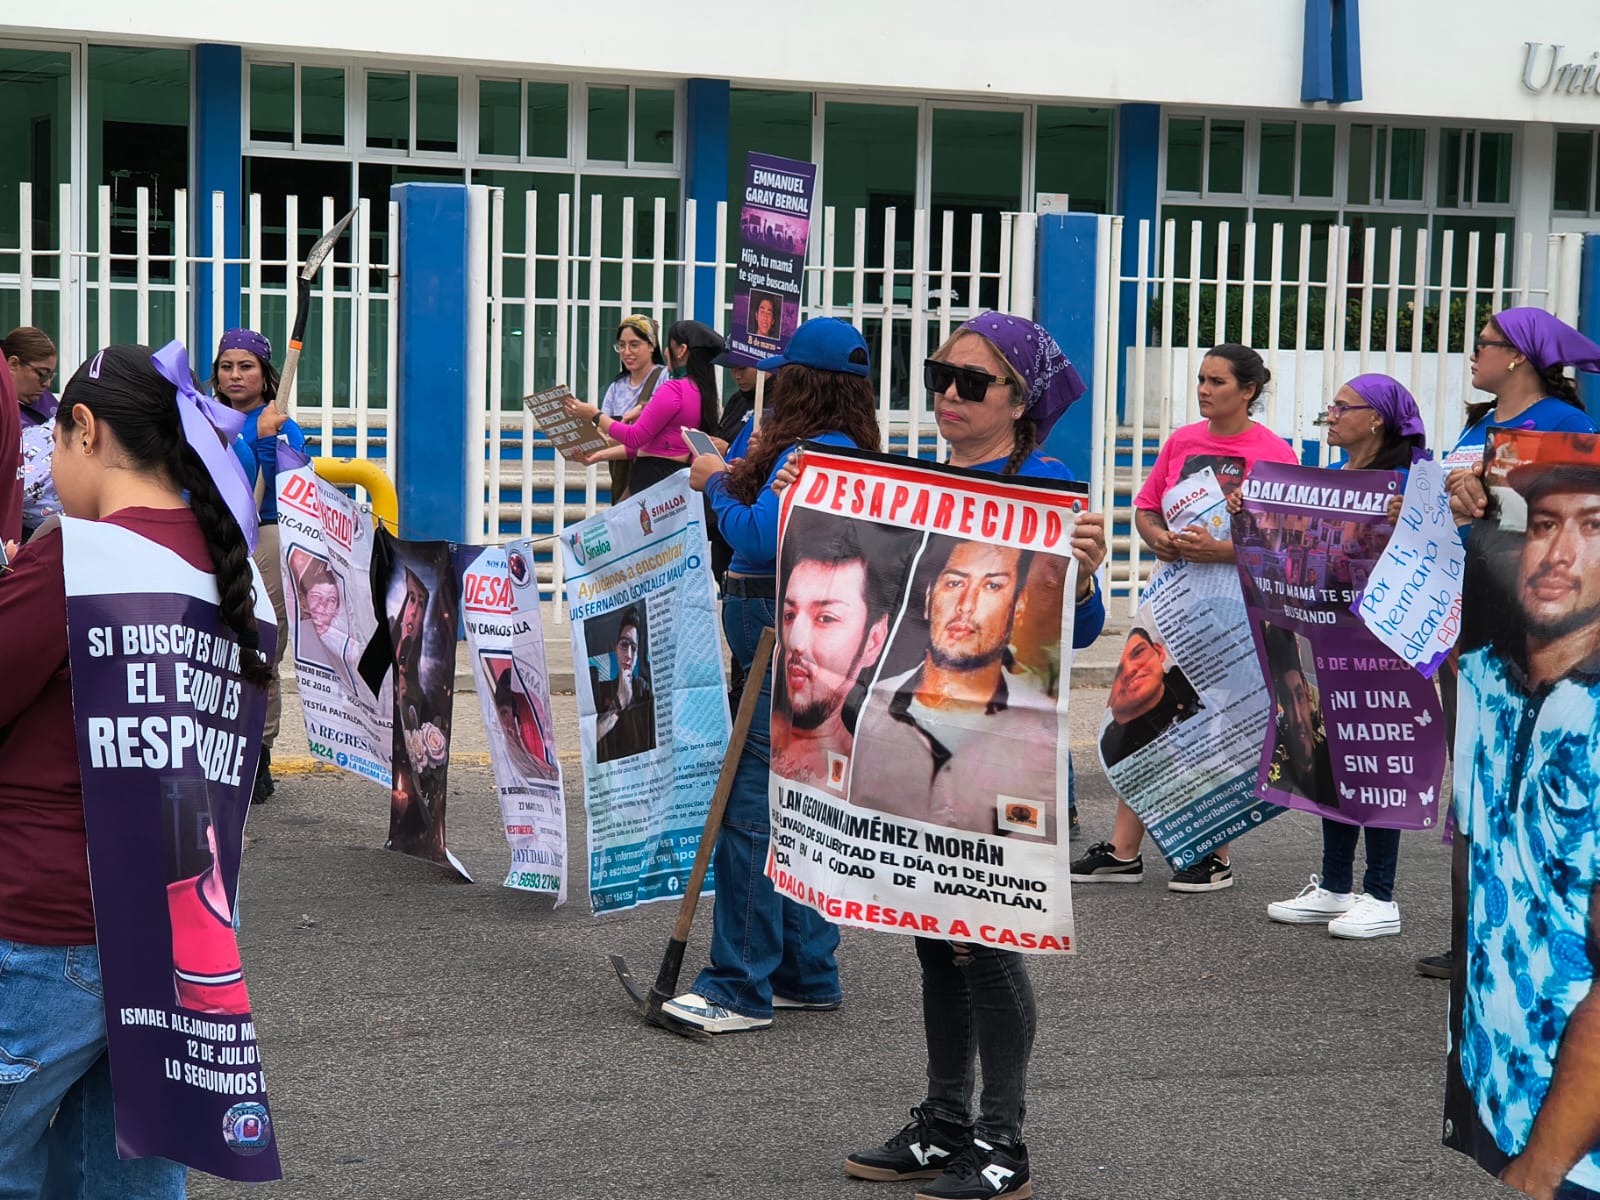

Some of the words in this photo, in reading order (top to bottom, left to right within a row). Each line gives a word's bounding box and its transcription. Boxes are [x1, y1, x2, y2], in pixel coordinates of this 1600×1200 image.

[753, 169, 804, 194] EMMANUEL
[745, 187, 776, 206] GARAY
[775, 192, 809, 213] BERNAL
[741, 247, 760, 268] Hijo,
[760, 254, 768, 267] tu
[770, 258, 794, 274] mamá
[739, 268, 747, 281] te
[747, 270, 765, 287] sigue
[766, 273, 800, 294] buscando.
[748, 335, 753, 345] 8
[753, 337, 760, 347] de
[651, 494, 686, 518] SINALOA
[1165, 486, 1208, 519] SINALOA
[1241, 479, 1285, 501] ADAN
[1285, 482, 1341, 508] ANAYA
[804, 471, 1063, 548] DESAPARECIDO
[585, 539, 611, 561] Sinaloa
[627, 564, 635, 577] a
[635, 542, 684, 575] encontrar
[1361, 576, 1392, 615] Por
[1401, 506, 1424, 532] tu
[584, 591, 630, 617] FERNANDO
[630, 574, 666, 600] GONZALEZ
[1274, 580, 1285, 595] TU
[1286, 582, 1317, 602] MAMÁ
[1319, 589, 1338, 602] TE
[1374, 539, 1439, 637] hermana
[1283, 604, 1337, 625] BUSCANDO
[1401, 588, 1451, 661] alzando
[1440, 559, 1462, 581] la
[478, 622, 512, 637] CARLOS
[88, 626, 113, 657] SI
[196, 631, 212, 664] ES
[211, 636, 230, 669] UN
[1316, 656, 1325, 670] 8
[1328, 657, 1349, 671] DE
[127, 662, 165, 704] EL
[221, 679, 242, 721] ES
[301, 677, 311, 688] DE
[313, 681, 331, 694] 2010
[1330, 690, 1357, 711] ¡NI
[1365, 691, 1412, 710] UNA
[1336, 722, 1415, 741] MADRE
[1344, 755, 1379, 774] SIN
[1386, 755, 1414, 774] SU
[1152, 826, 1163, 839] Si
[1164, 811, 1193, 832] tienes
[1195, 780, 1246, 814] información
[1359, 786, 1407, 808] HIJO!
[802, 795, 844, 831] GEOVANNI
[924, 831, 1004, 867] MORÁN
[1185, 825, 1192, 834] o
[1195, 839, 1213, 853] 669
[1212, 831, 1227, 844] 327
[1226, 820, 1247, 836] 8424
[806, 826, 816, 841] DE
[815, 831, 826, 846] SU
[880, 851, 899, 867] EL
[903, 855, 934, 874] DÍA
[937, 863, 957, 878] 01
[963, 867, 985, 882] DE
[986, 873, 1047, 893] JUNIO
[518, 872, 540, 888] 6693
[812, 849, 822, 864] LA
[893, 873, 916, 888] DE
[934, 881, 1047, 913] MAZATLÁN,
[808, 887, 816, 905] A
[949, 919, 971, 937] A
[979, 925, 1071, 951] CASA!
[120, 1007, 169, 1029] ISMAEL
[171, 1013, 237, 1042] ALEJANDRO
[187, 1039, 199, 1059] 12
[201, 1043, 214, 1063] DE
[218, 1046, 254, 1066] JULIO
[165, 1057, 181, 1081] LO
[184, 1062, 257, 1095] SEGUIMOS
